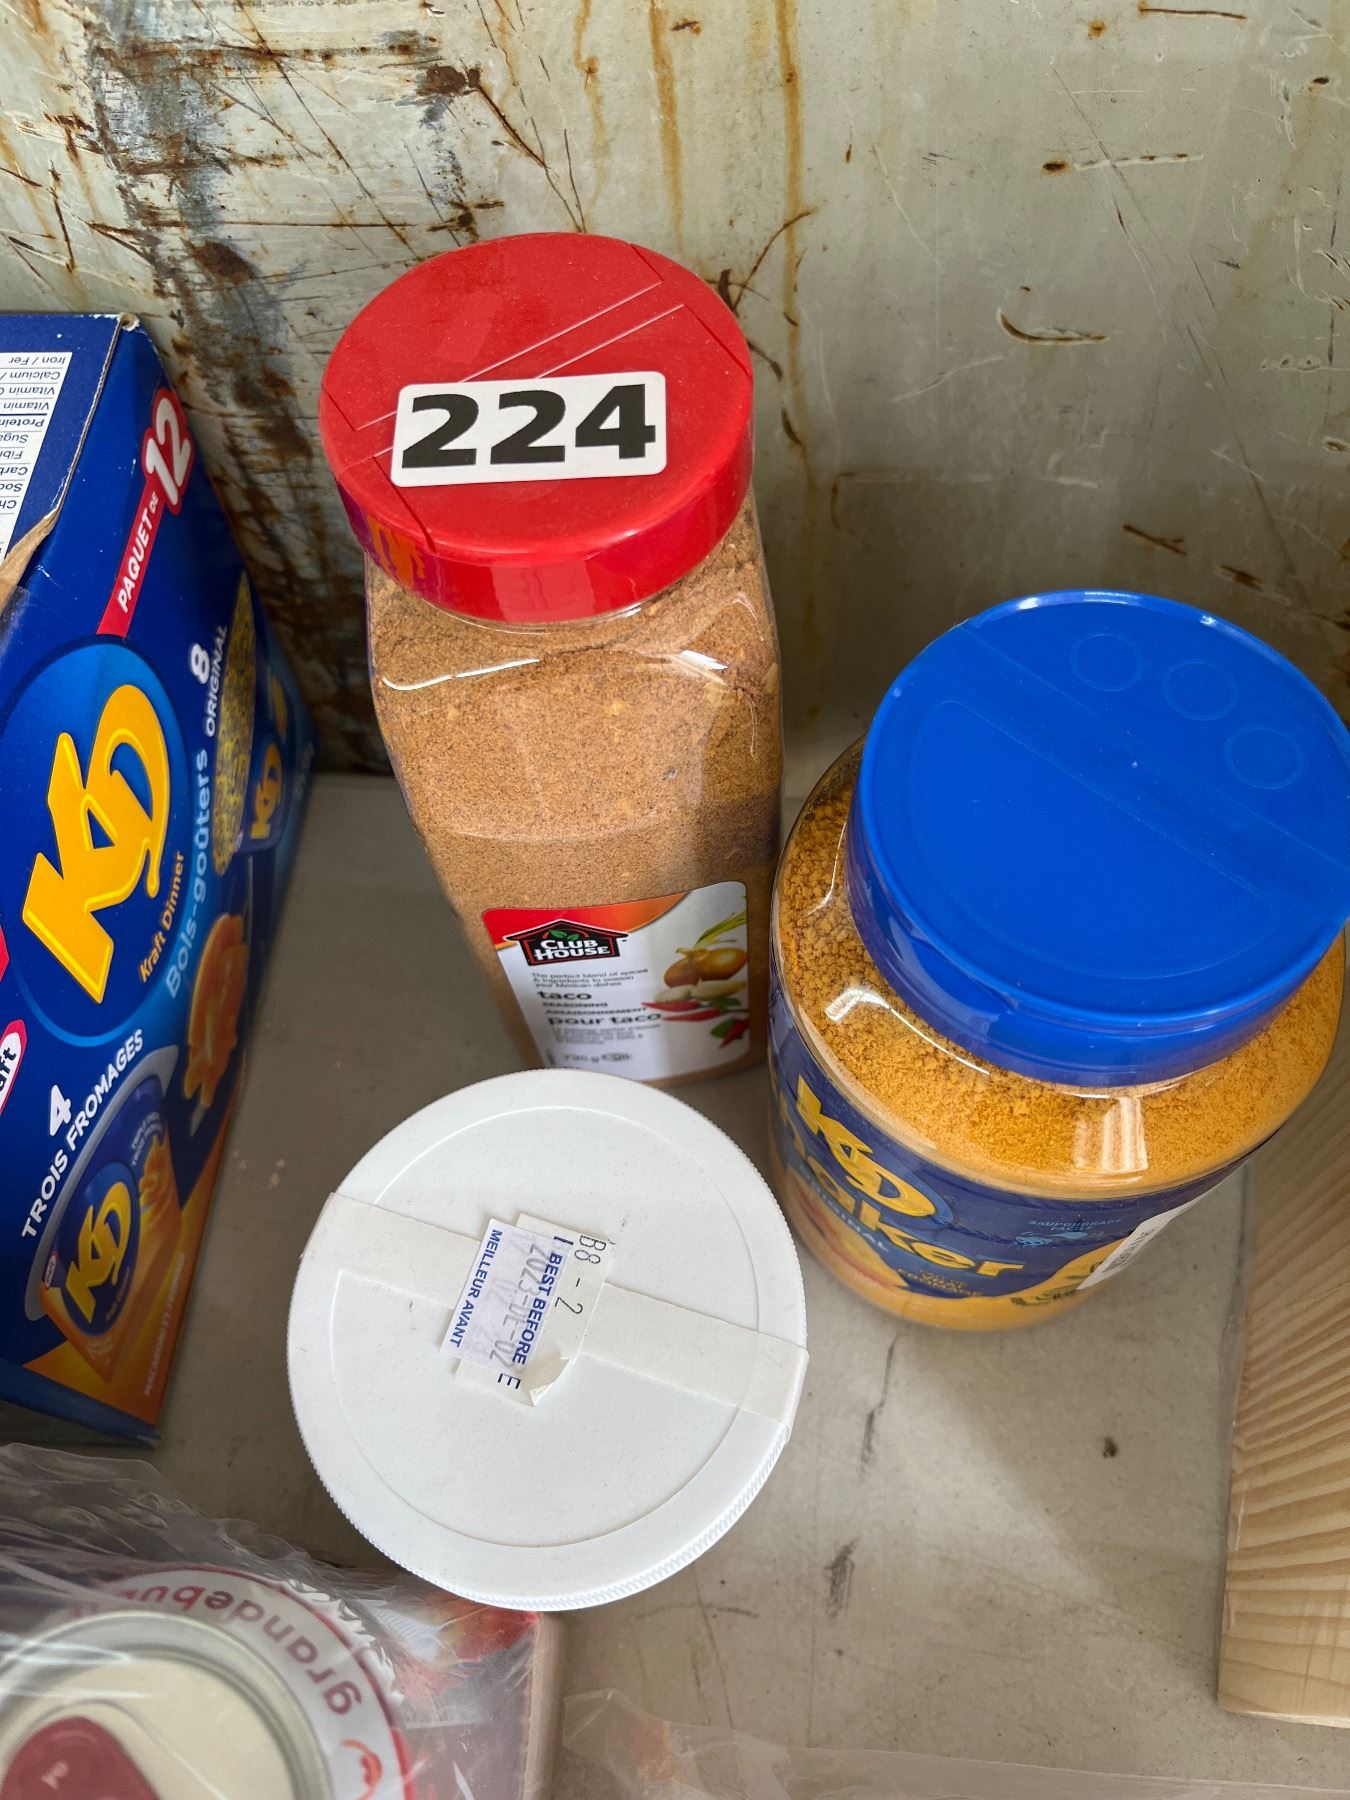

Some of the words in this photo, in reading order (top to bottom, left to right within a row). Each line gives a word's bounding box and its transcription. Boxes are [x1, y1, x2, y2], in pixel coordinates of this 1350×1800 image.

[8, 356, 30, 365] Fer
[10, 371, 61, 380] Calcium
[42, 356, 66, 365] Iron
[3, 402, 50, 411] Vitamin
[9, 386, 55, 395] Vitamin
[401, 383, 656, 469] 224
[145, 397, 192, 506] 12
[149, 492, 160, 514] DE
[117, 508, 157, 613] PAQUET
[190, 643, 210, 684] 8
[205, 626, 227, 737] ORIGINAL
[22, 684, 170, 1004] KD
[139, 930, 167, 983] Kraft
[161, 851, 184, 931] Dinner
[534, 945, 611, 960] HOUSE
[540, 938, 599, 950] CLUB
[537, 990, 592, 1000] taco
[548, 1016, 604, 1026] pour
[611, 1013, 662, 1024] taco
[49, 1084, 72, 1136] 4
[21, 1149, 69, 1239] TROIS
[66, 1028, 146, 1150] FROMAGES
[797, 1074, 937, 1218] KD
[65, 1181, 131, 1324] KD
[468, 1229, 503, 1299] MEILLEUR
[538, 1252, 563, 1296] BEST
[449, 1300, 475, 1348] AVANT
[554, 1296, 584, 1315] 2
[512, 1297, 547, 1366] BEFORE
